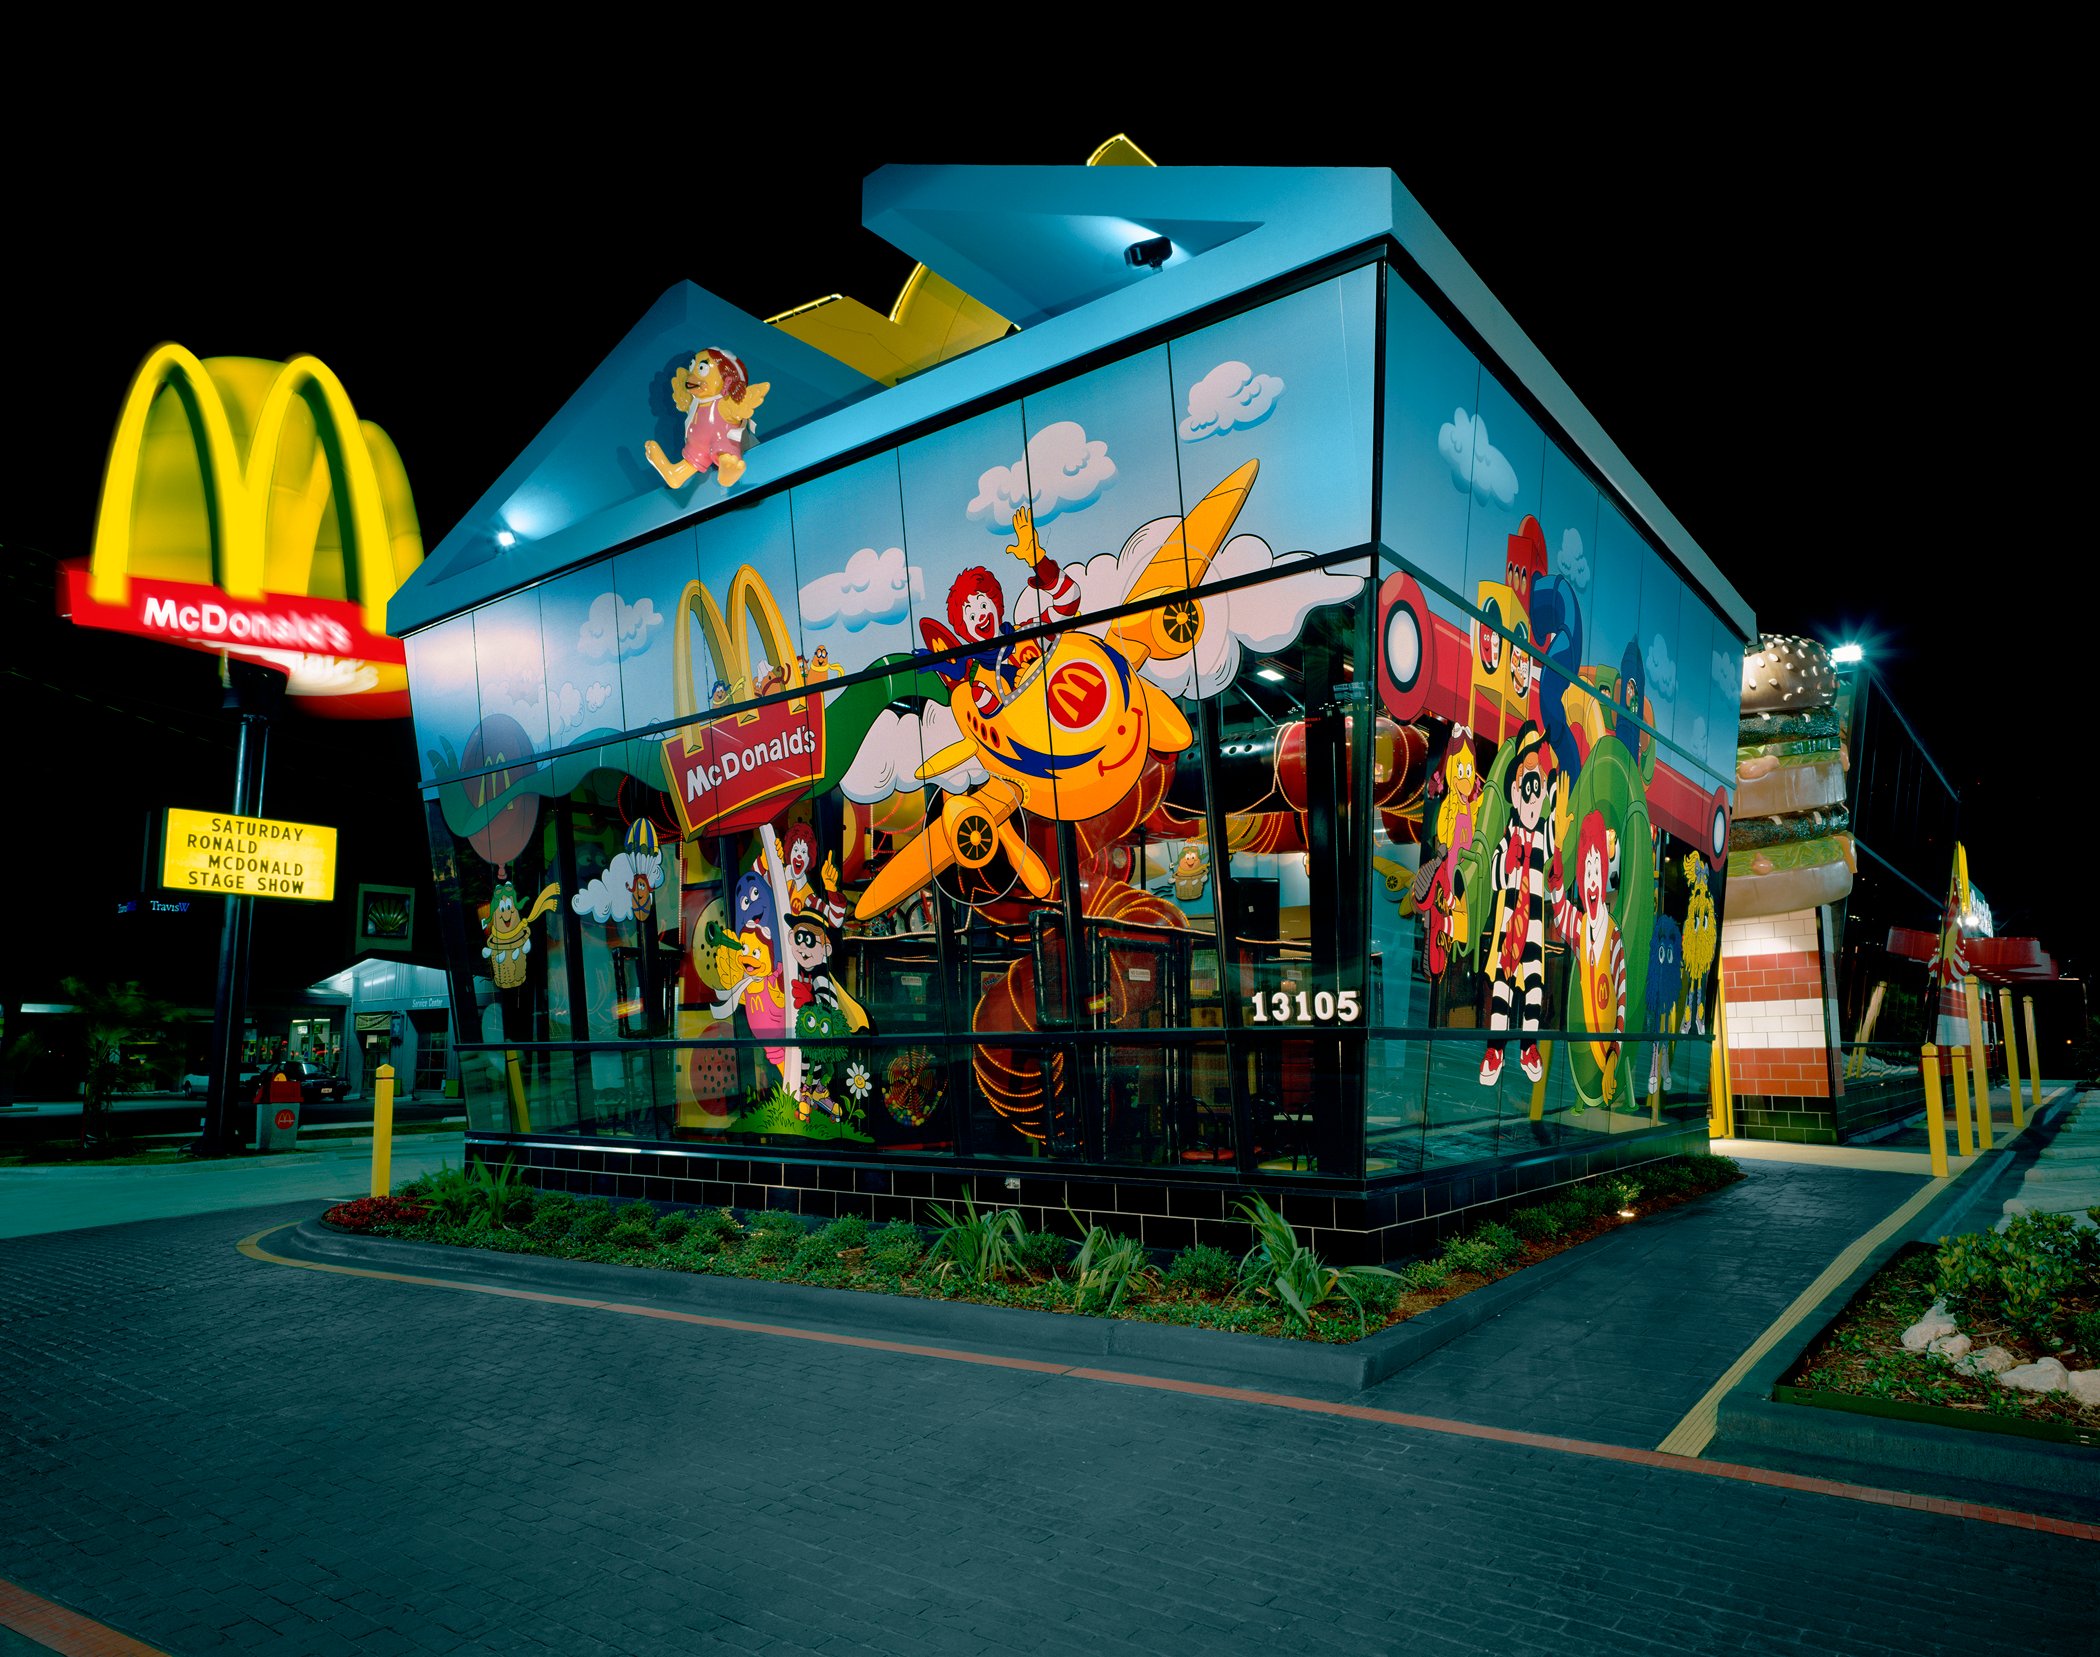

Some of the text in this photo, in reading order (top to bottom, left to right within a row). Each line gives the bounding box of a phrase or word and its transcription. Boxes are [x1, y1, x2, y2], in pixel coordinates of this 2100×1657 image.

[686, 725, 816, 803] McDonald's
[211, 818, 304, 842] SATURDAY
[187, 833, 258, 854] RONALD
[208, 854, 303, 877] MCDONALD
[188, 870, 305, 895] STAGE SHOW
[1251, 990, 1361, 1022] 13105
